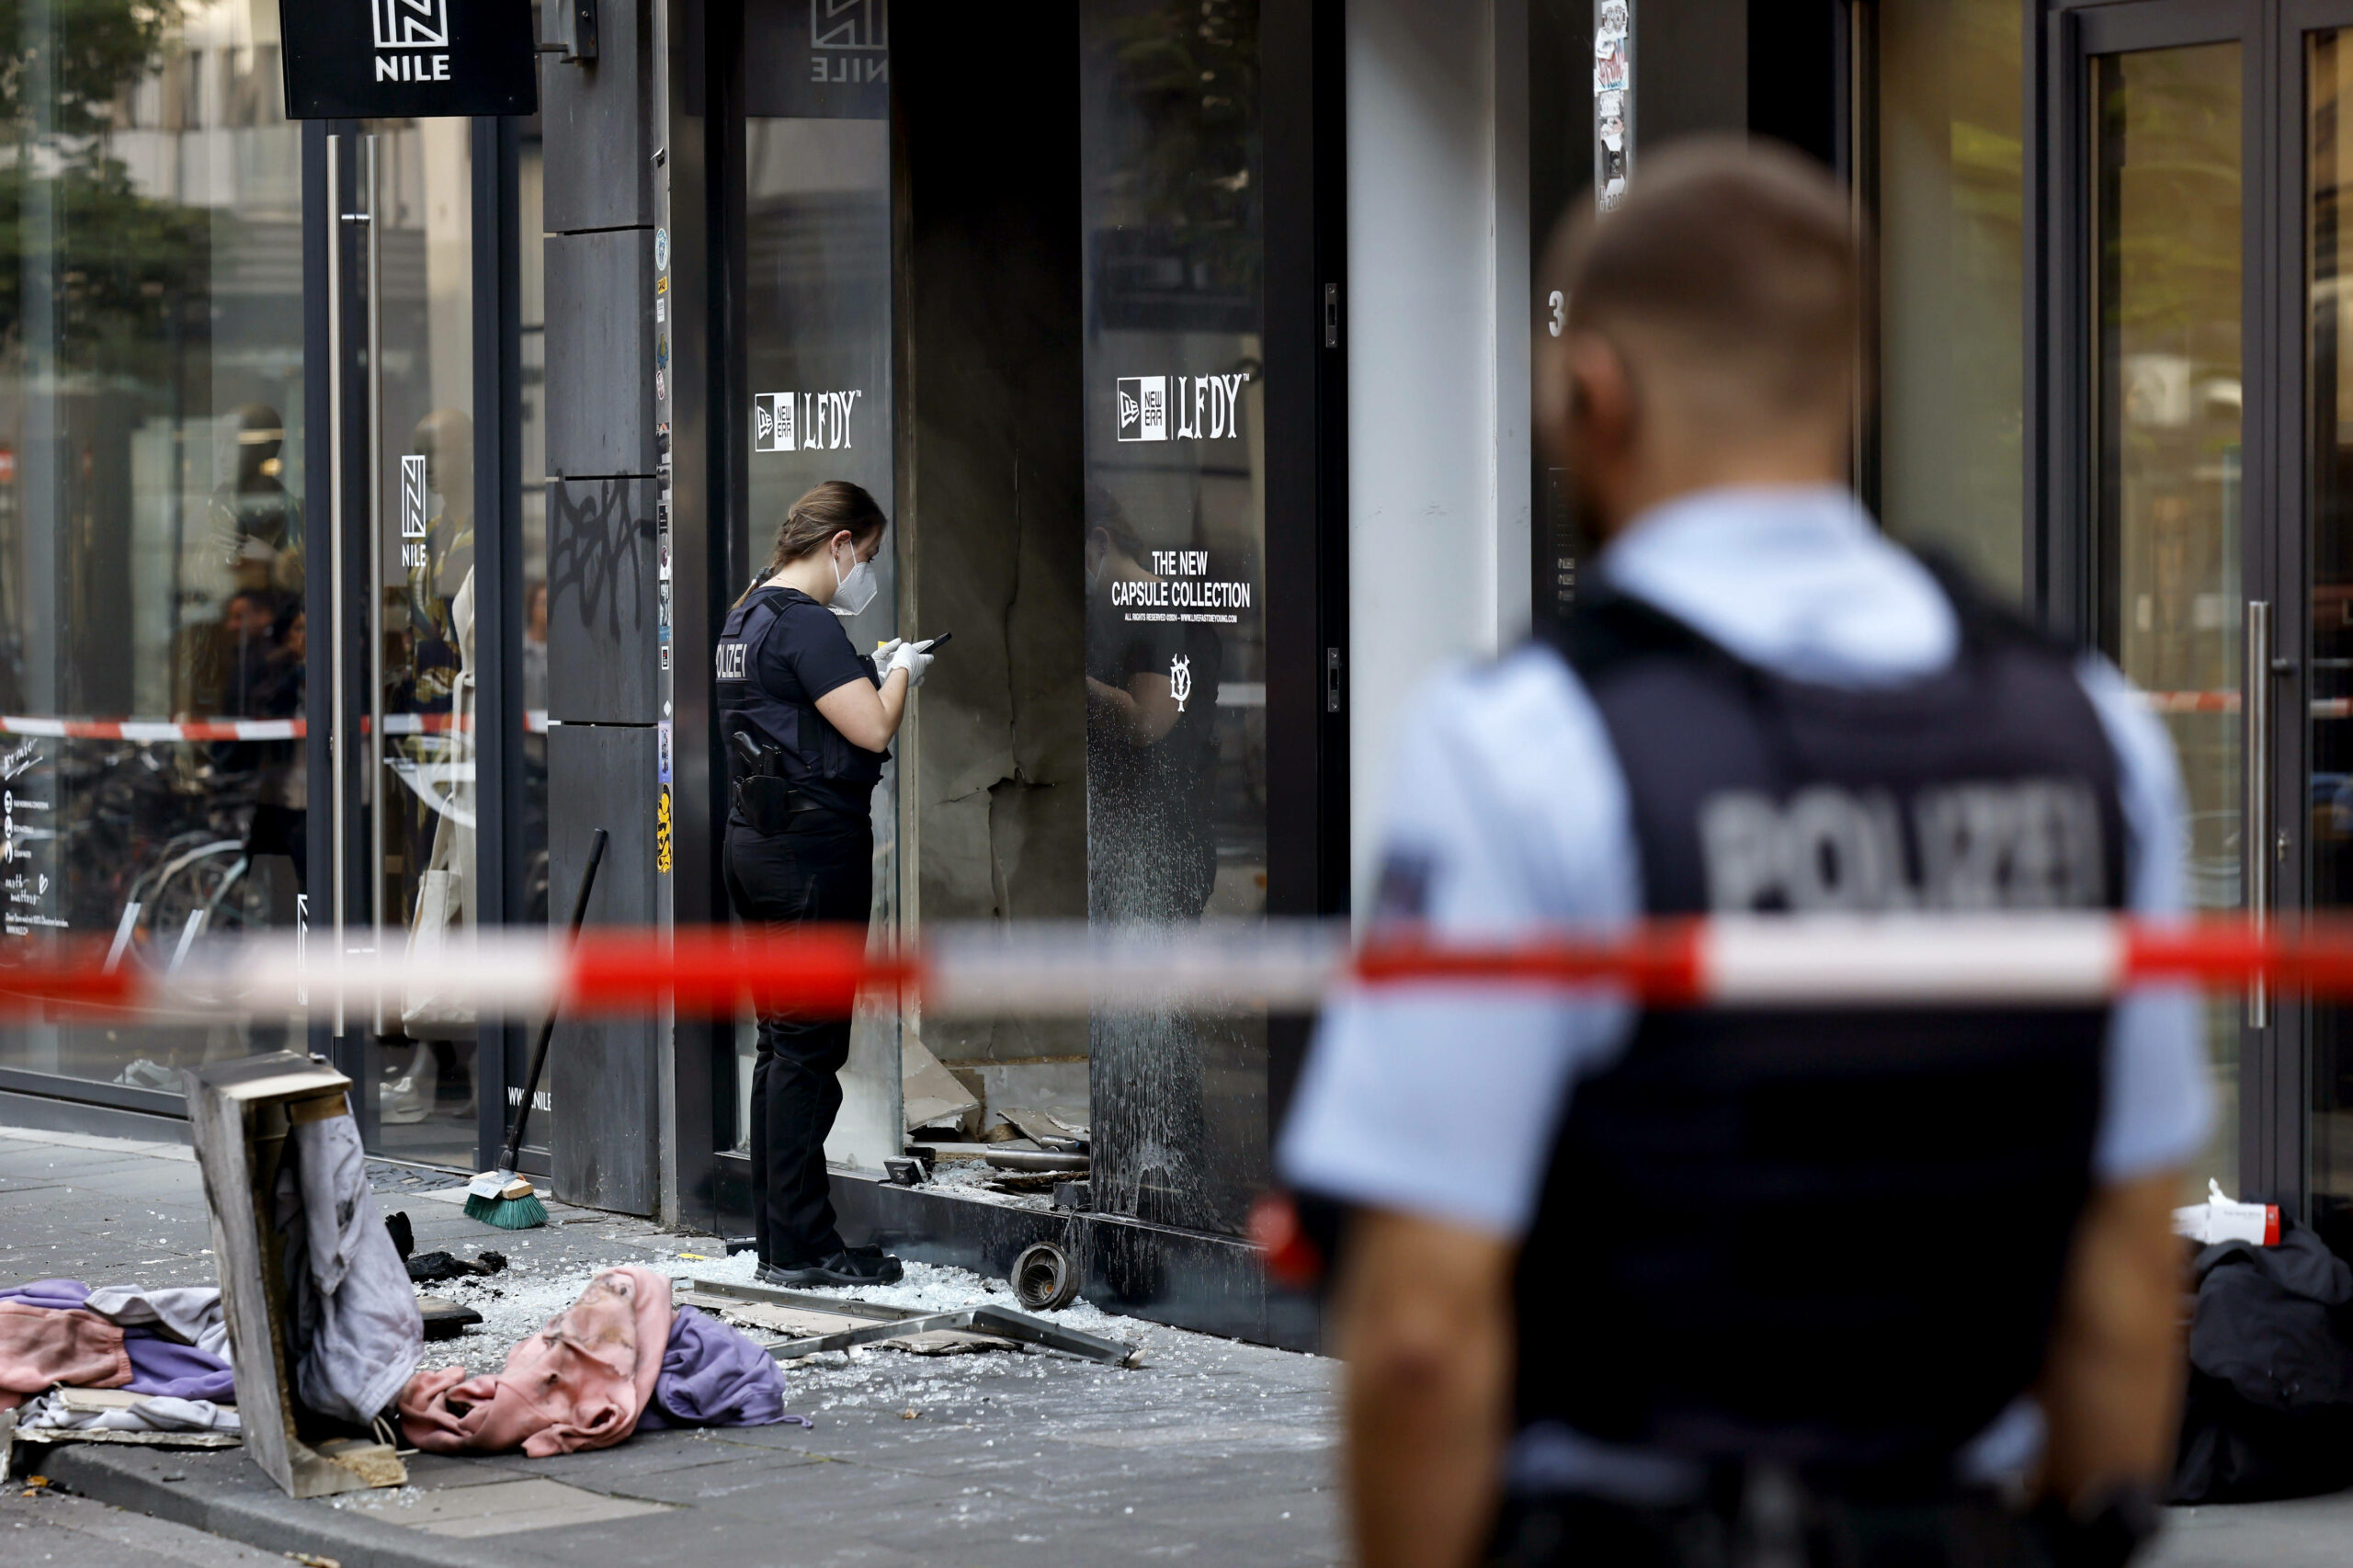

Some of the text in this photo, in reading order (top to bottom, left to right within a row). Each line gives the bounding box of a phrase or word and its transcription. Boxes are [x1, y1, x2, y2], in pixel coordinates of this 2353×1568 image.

[375, 55, 450, 82] NILE
[1145, 392, 1162, 407] NEW
[778, 405, 791, 421] NEW
[1145, 409, 1162, 426] ERA
[778, 423, 791, 437] ERA
[402, 544, 426, 567] NILE
[1152, 551, 1208, 575] THE NEW
[1111, 581, 1250, 608] CAPSULE COLLECTION
[715, 643, 747, 678] OLIZEI
